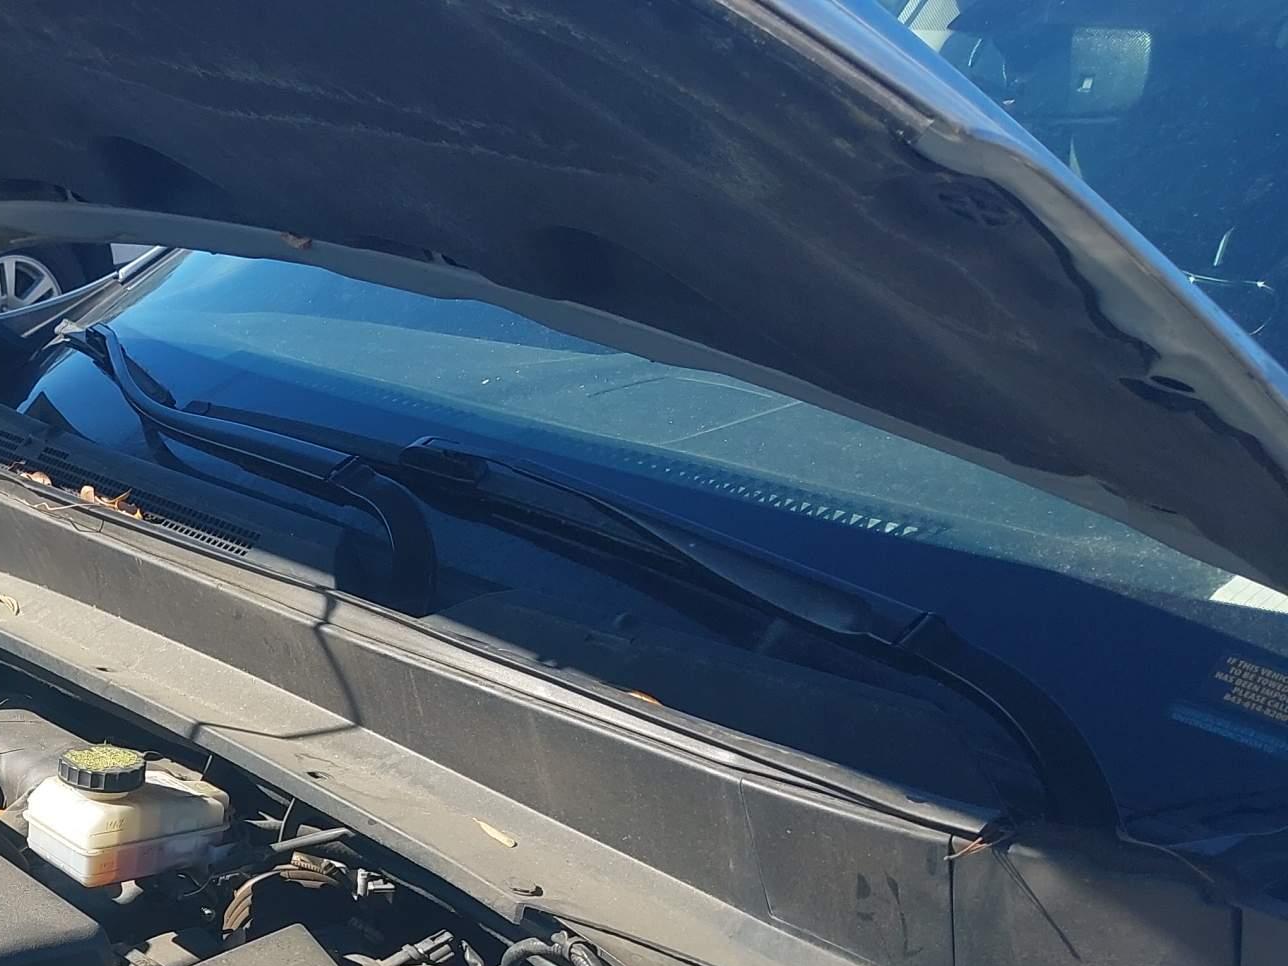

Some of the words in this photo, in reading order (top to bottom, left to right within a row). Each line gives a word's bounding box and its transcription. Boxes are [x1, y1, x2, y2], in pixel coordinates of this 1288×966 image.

[1229, 667, 1242, 676] TO
[1238, 660, 1260, 672] THIS
[1215, 671, 1235, 683] HAS
[1235, 679, 1262, 692] BEEN
[1261, 687, 1288, 703] IMPO
[1232, 687, 1267, 704] PLEASE
